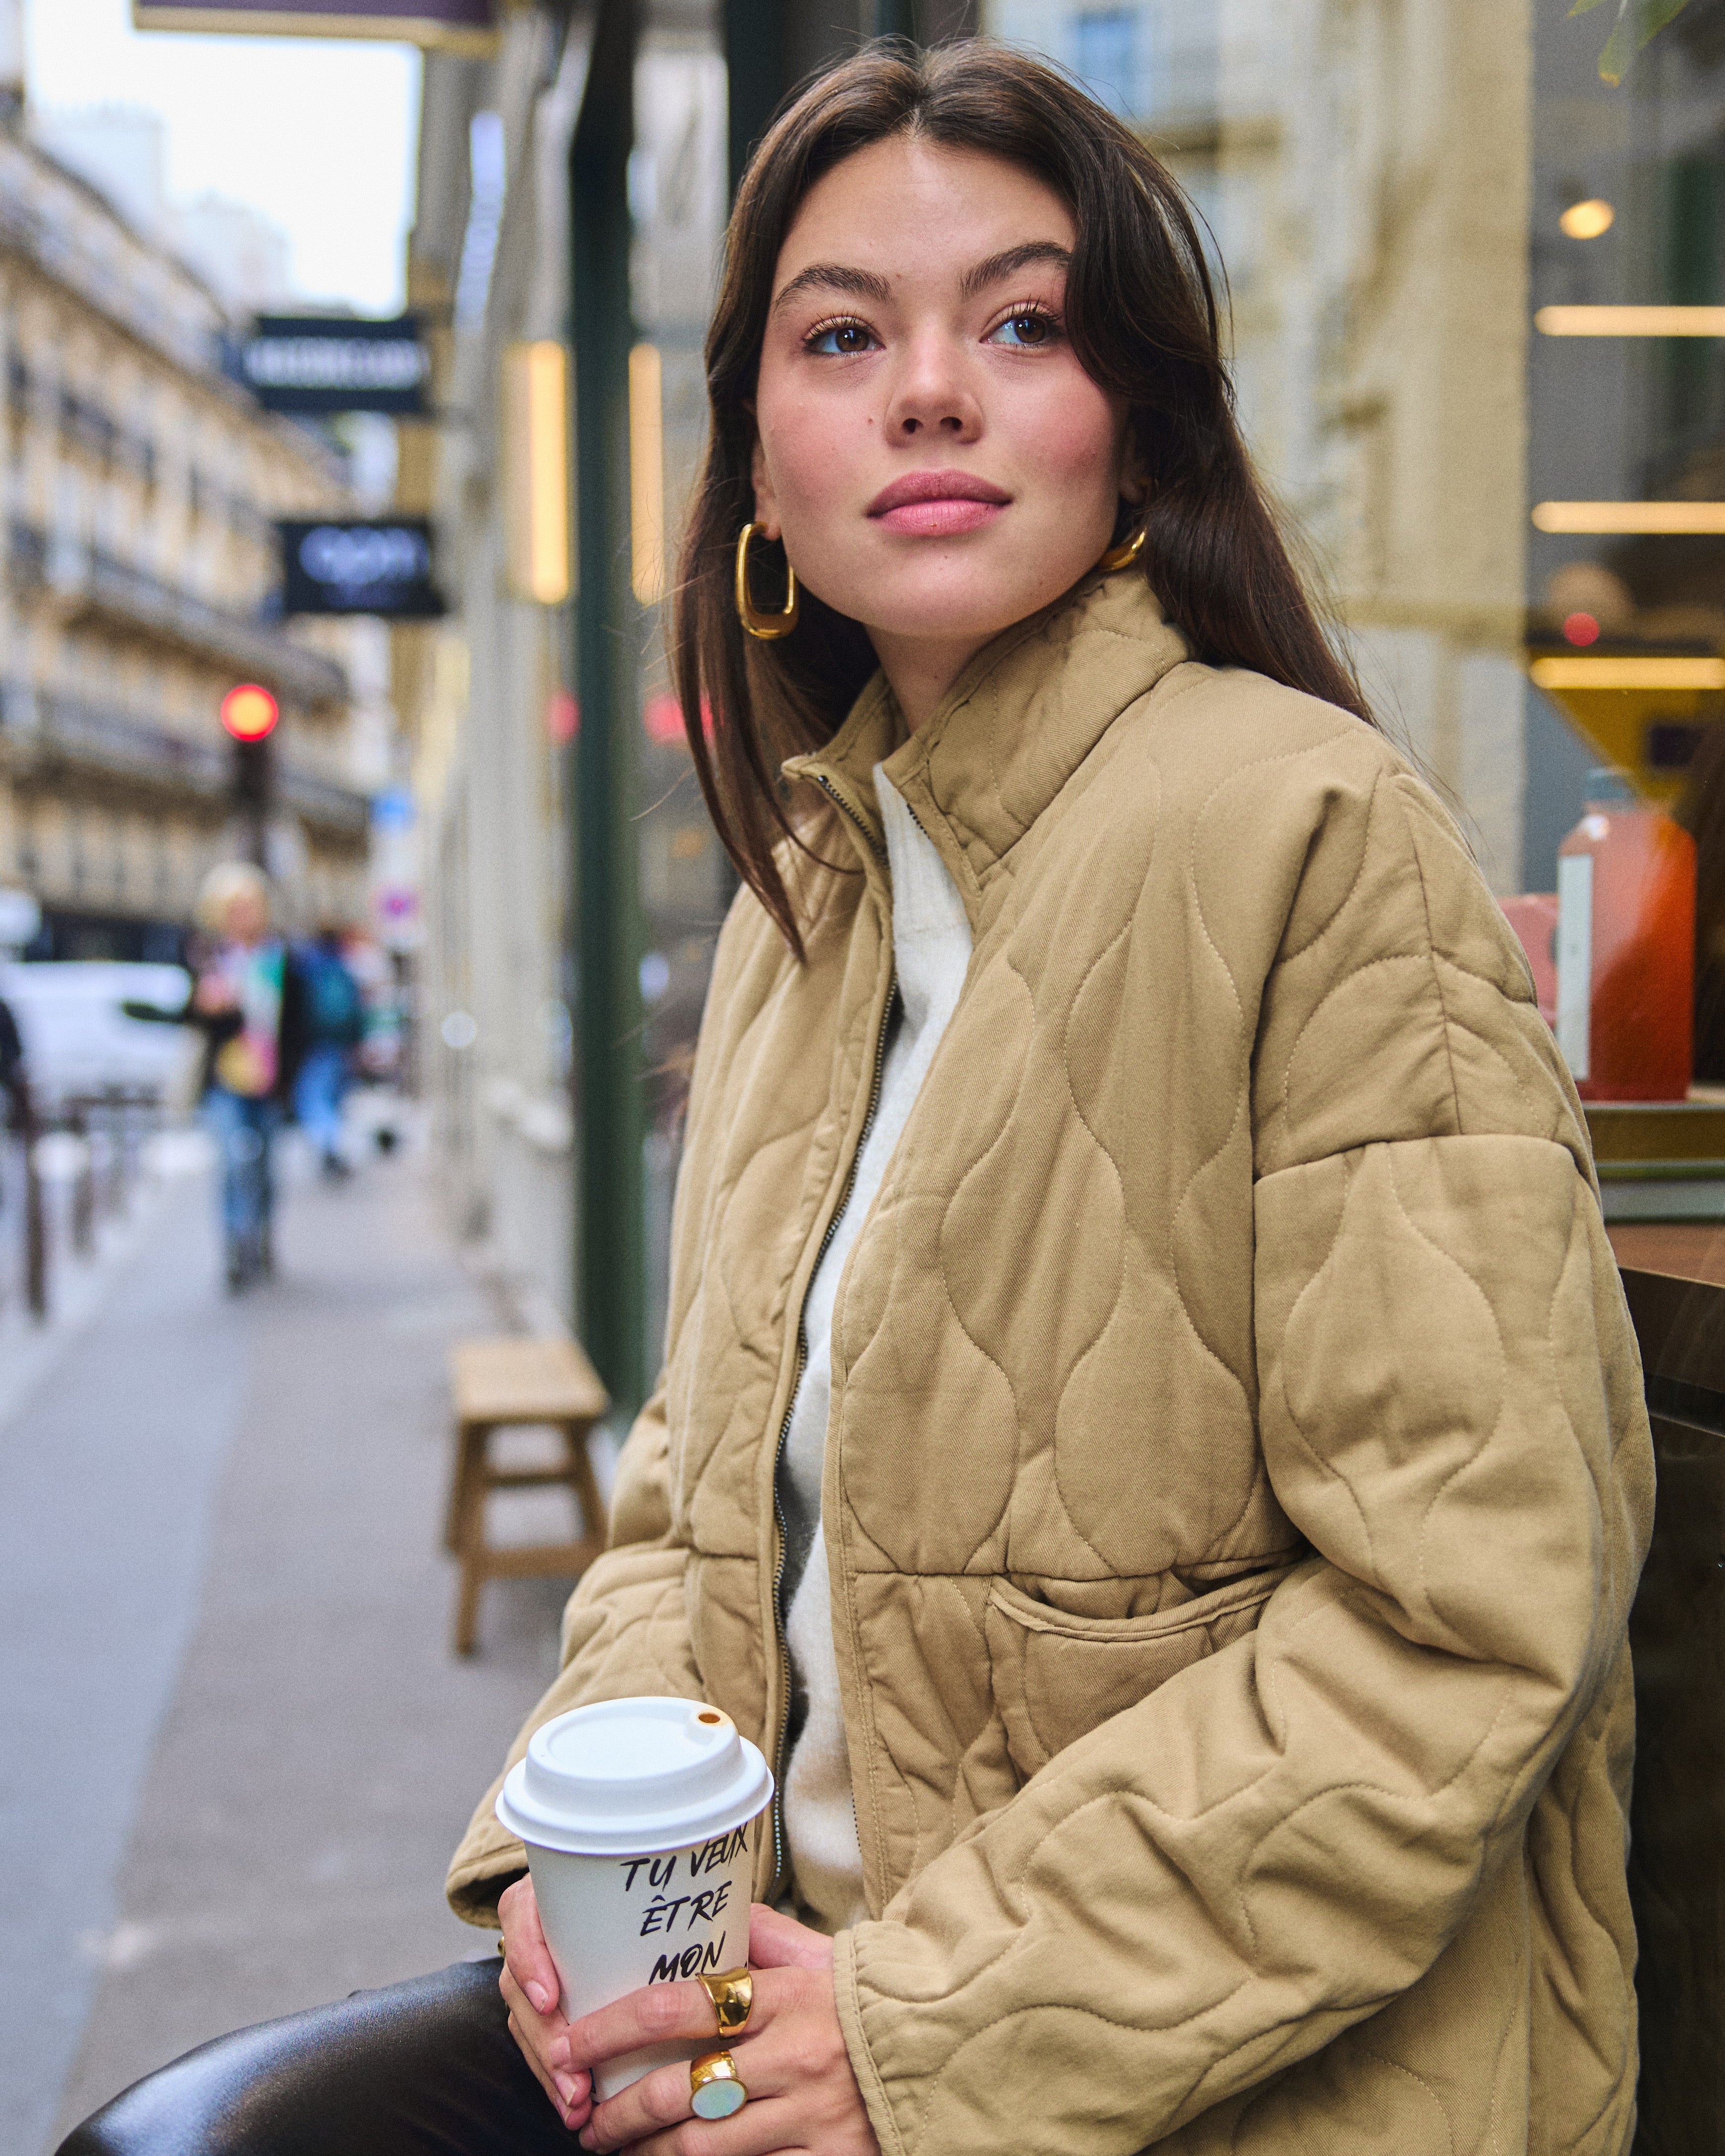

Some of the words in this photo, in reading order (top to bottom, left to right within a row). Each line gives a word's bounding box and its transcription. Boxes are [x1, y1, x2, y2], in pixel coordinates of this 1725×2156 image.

[620, 1855, 676, 1891] TU
[691, 1822, 748, 1877] VEUX
[640, 1880, 732, 1937] ÊTRE
[648, 1931, 726, 1985] MON
